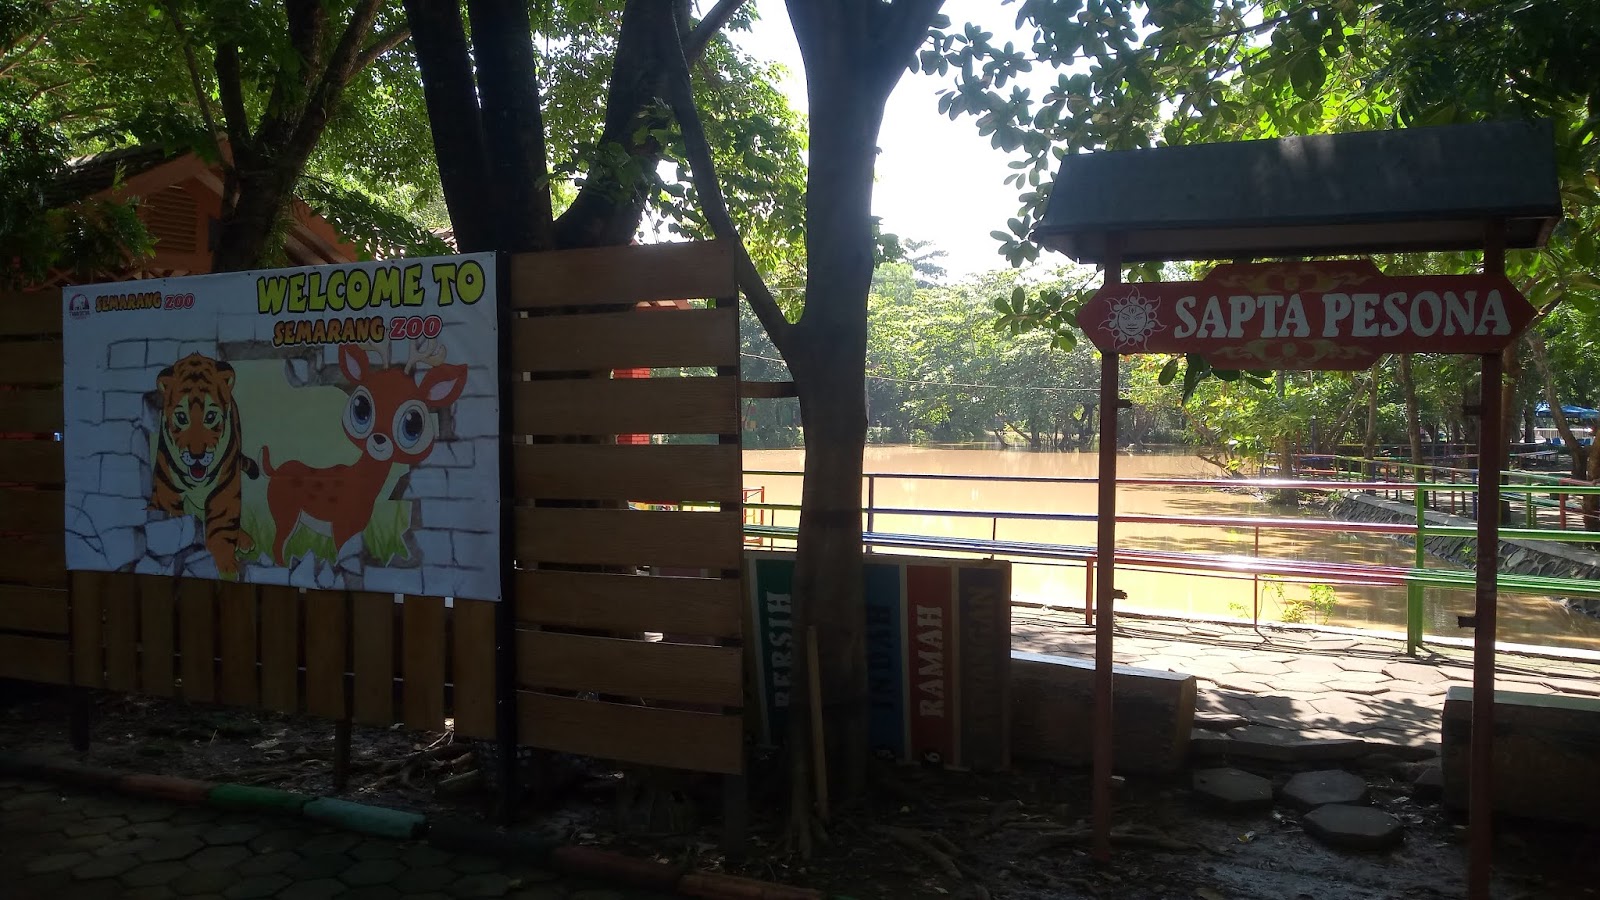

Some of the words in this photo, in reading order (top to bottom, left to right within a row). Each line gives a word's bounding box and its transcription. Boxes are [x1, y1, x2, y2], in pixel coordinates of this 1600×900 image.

[95, 291, 162, 312] SEMARANG
[164, 293, 195, 310] ZOO
[257, 264, 425, 314] WELCOME
[432, 260, 486, 305] TO
[273, 317, 385, 347] SEMARANG
[388, 315, 442, 340] ZOO
[1174, 294, 1310, 339] SAPTA
[1322, 289, 1511, 337] PESONA
[917, 604, 944, 718] RAMAH
